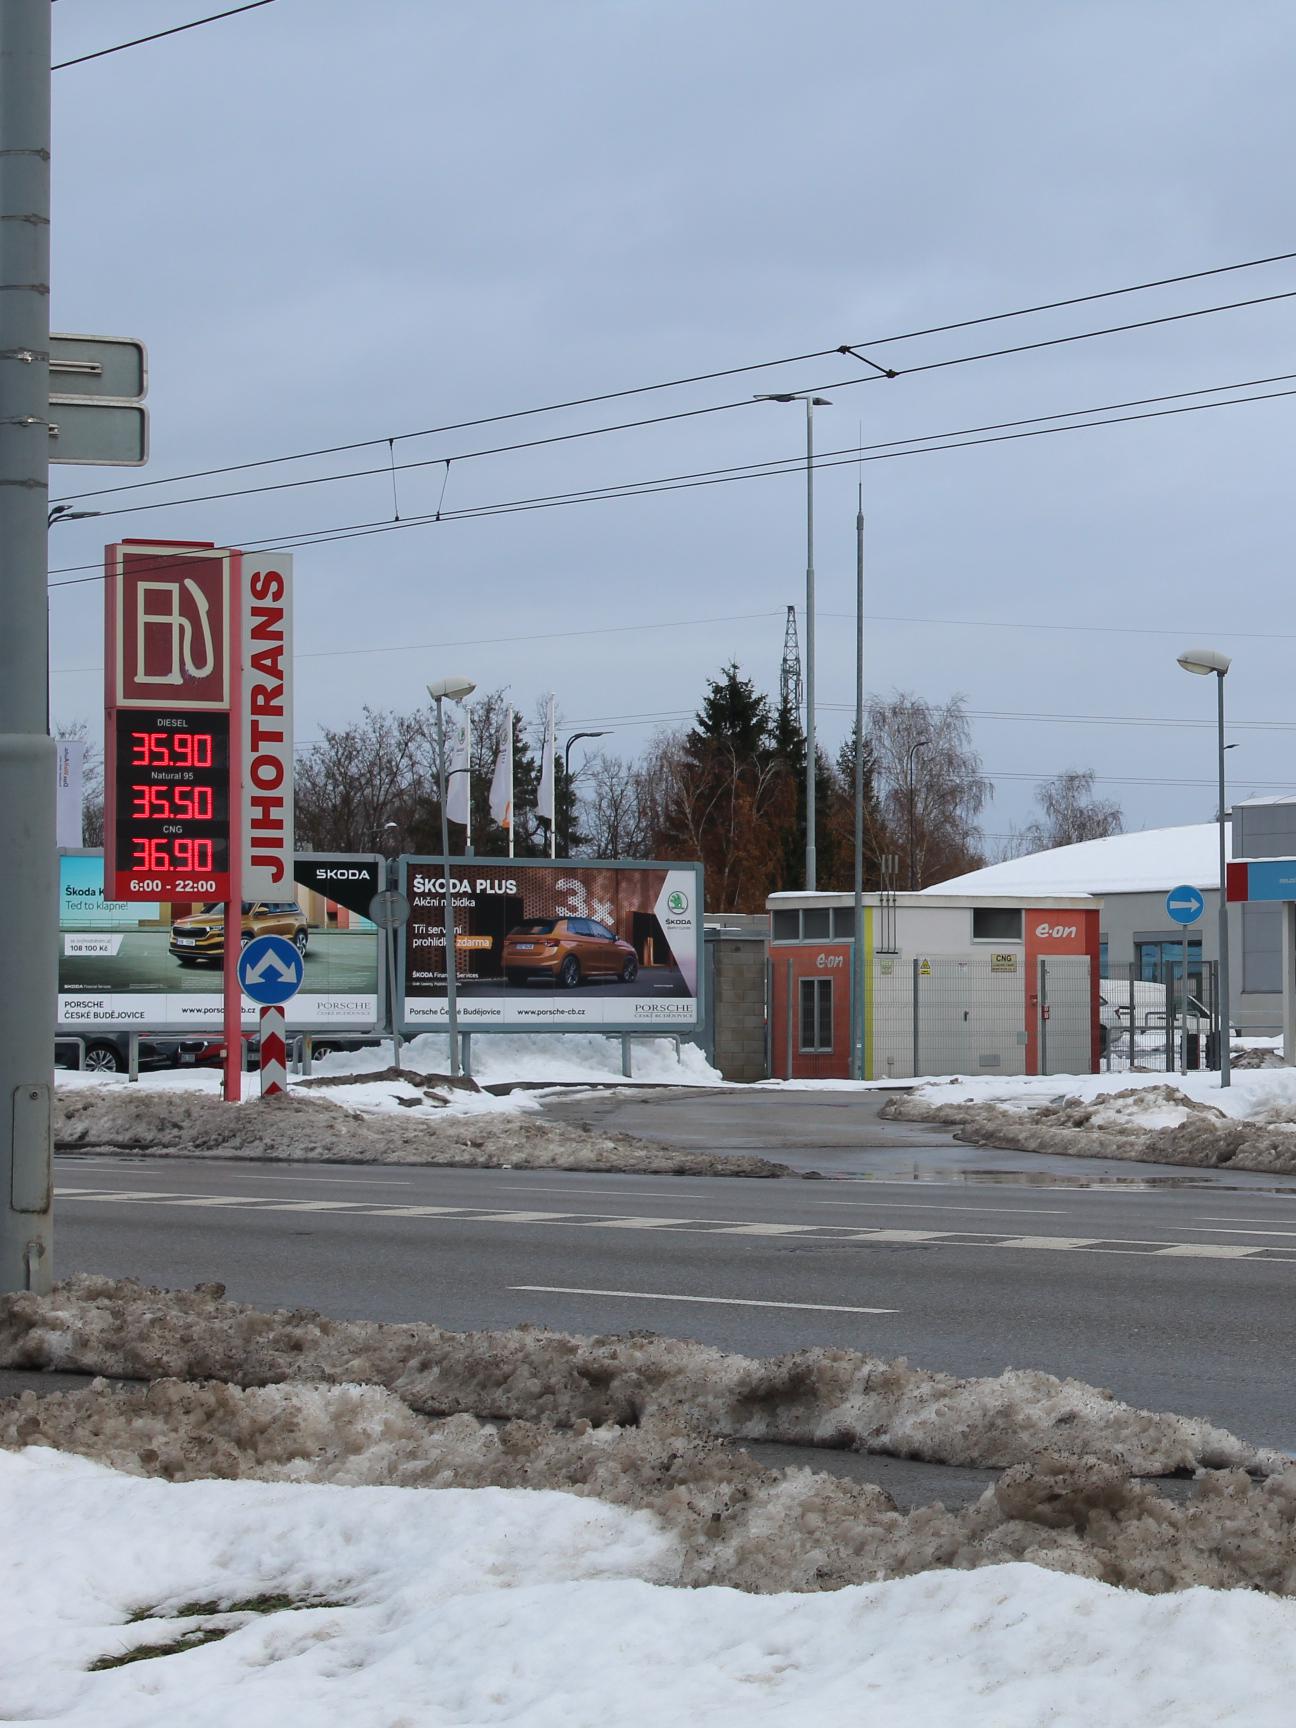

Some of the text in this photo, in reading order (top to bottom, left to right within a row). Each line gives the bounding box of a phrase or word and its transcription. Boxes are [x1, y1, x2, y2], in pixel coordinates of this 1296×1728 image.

[157, 718, 188, 728] DIESEL
[250, 569, 285, 885] JIHOTRANS
[131, 732, 213, 767] 35.90
[151, 770, 194, 781] Natural 95
[131, 785, 213, 819] 35.50
[163, 824, 183, 834] CNG
[131, 838, 213, 872] 36.90
[130, 879, 162, 893] 6:00
[175, 879, 216, 893] 22:00
[413, 874, 517, 894] ŠKODA PLUS
[65, 884, 96, 896] Škoda
[84, 901, 94, 910] to
[413, 896, 476, 907] Akční nbídka
[555, 877, 616, 926] 3x
[412, 923, 462, 934] Tři servní
[413, 936, 490, 949] prohlíd zdarma
[64, 1001, 104, 1009] PORSCHE
[181, 1006, 256, 1015] www.porscb.cz
[317, 1001, 371, 1009] PORSCHE
[635, 1004, 693, 1012] PORSCHE
[64, 1010, 145, 1019] ČESKÉ BUDĚJOVICE
[409, 1006, 501, 1017] Porsche Čeé Budějovice
[517, 1008, 586, 1017] www.porsche-cb.cz
